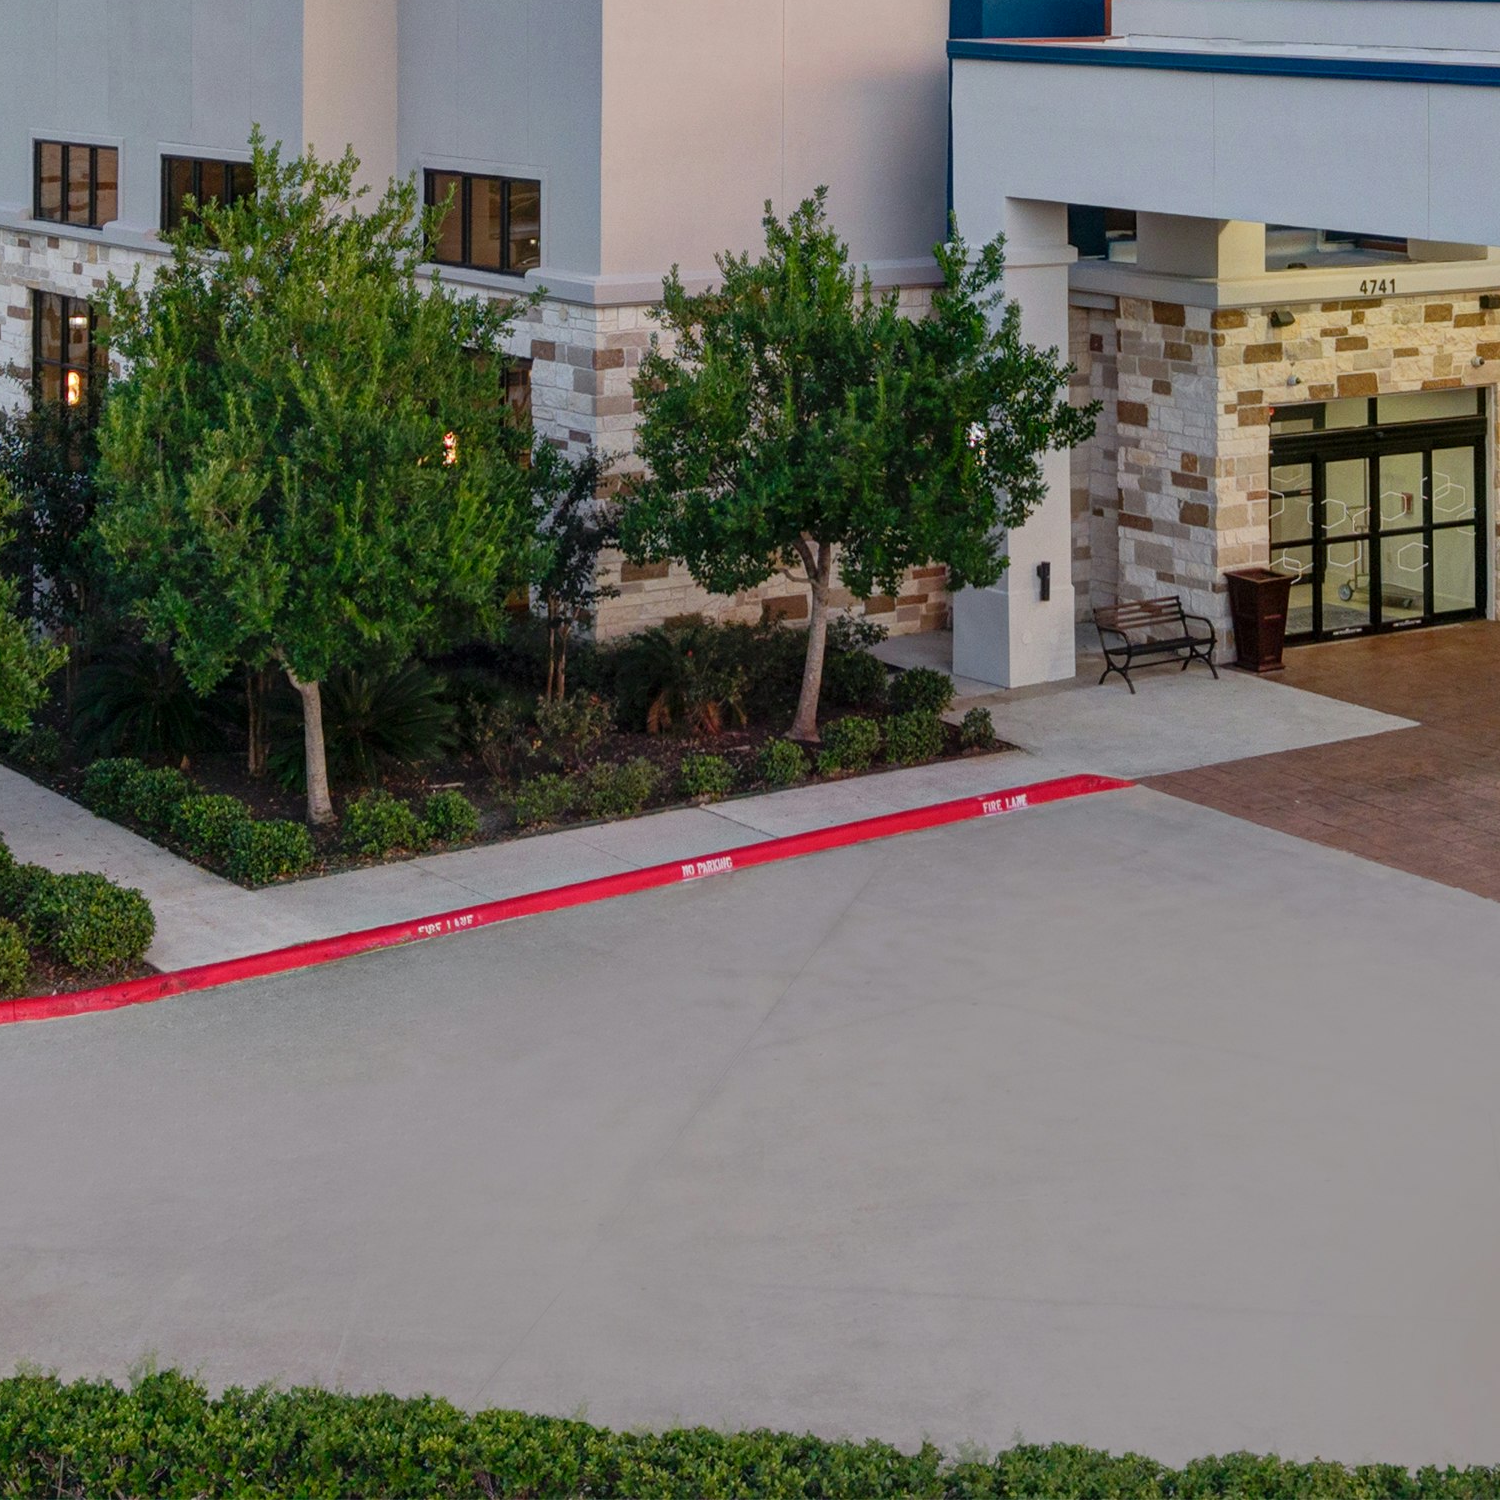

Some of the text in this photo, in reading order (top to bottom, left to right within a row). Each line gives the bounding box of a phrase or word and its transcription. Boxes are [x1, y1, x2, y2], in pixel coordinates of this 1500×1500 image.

[1359, 278, 1396, 295] 4741
[982, 793, 1028, 814] FIRE LANE
[681, 856, 733, 877] NO PARKING
